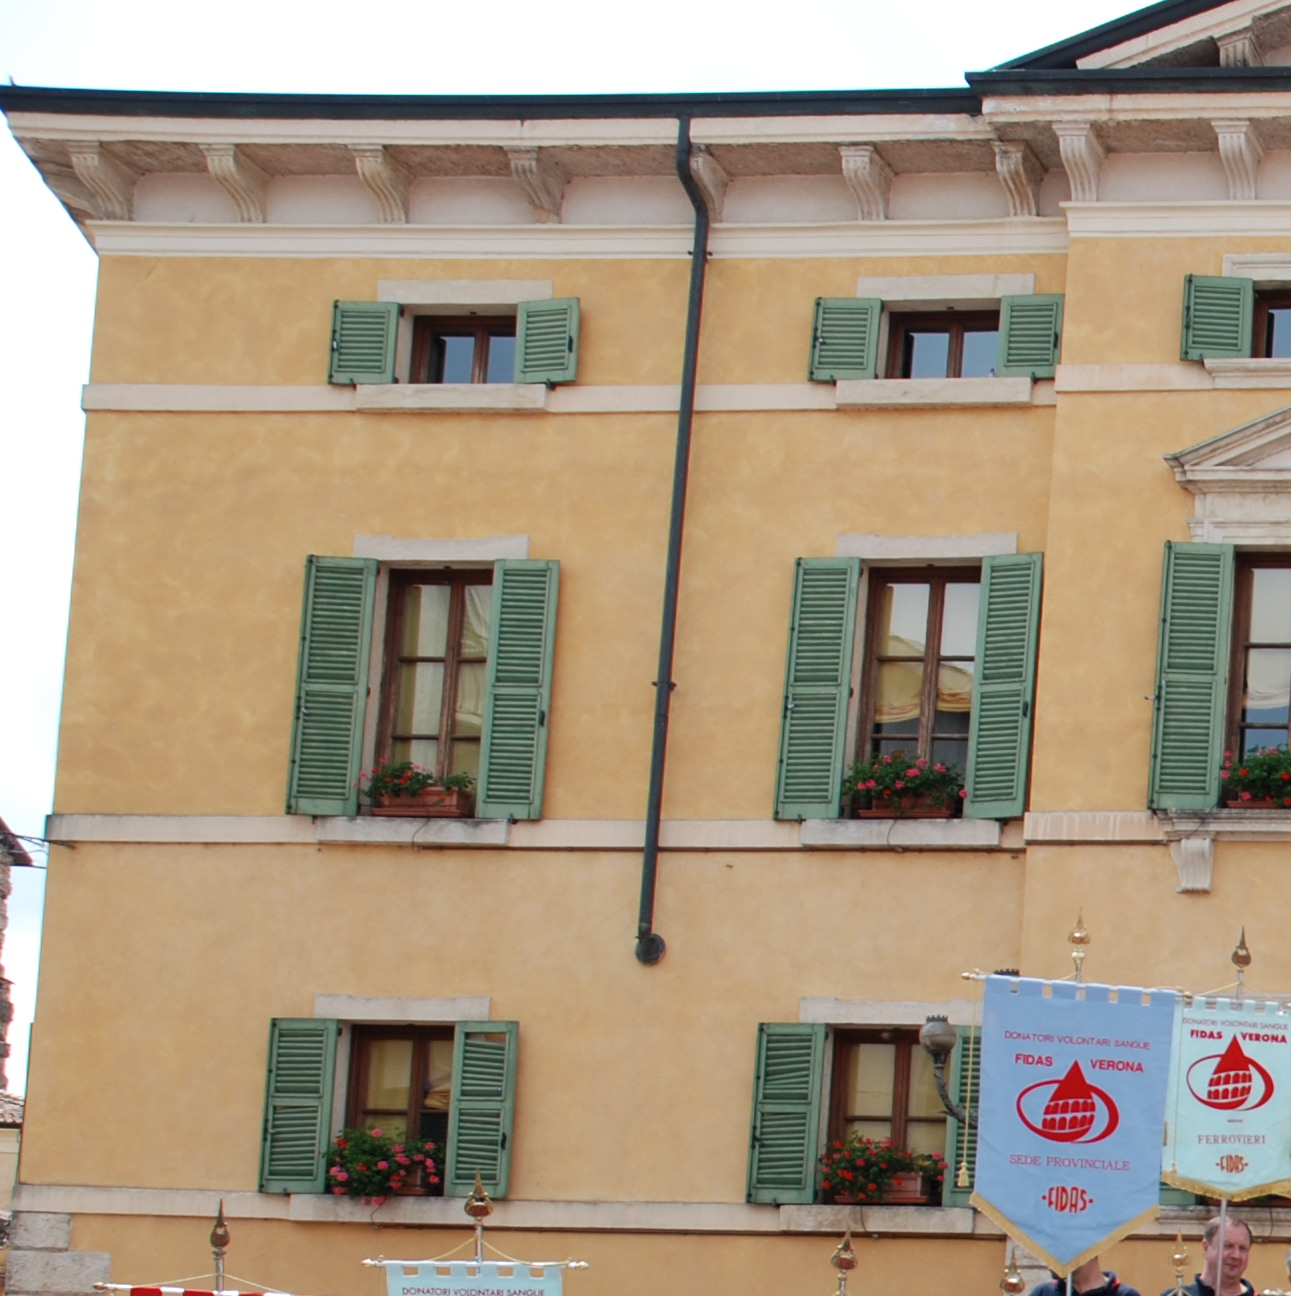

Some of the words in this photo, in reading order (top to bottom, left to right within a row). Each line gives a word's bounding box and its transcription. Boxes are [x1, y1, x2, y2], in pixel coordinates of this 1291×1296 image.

[1015, 1053, 1053, 1067] FIDAS
[1090, 1059, 1143, 1073] VERONA
[1198, 1135, 1265, 1144] FERROVIERI
[1009, 1154, 1042, 1166] SEDE
[1046, 1156, 1130, 1171] PROVINCIALE
